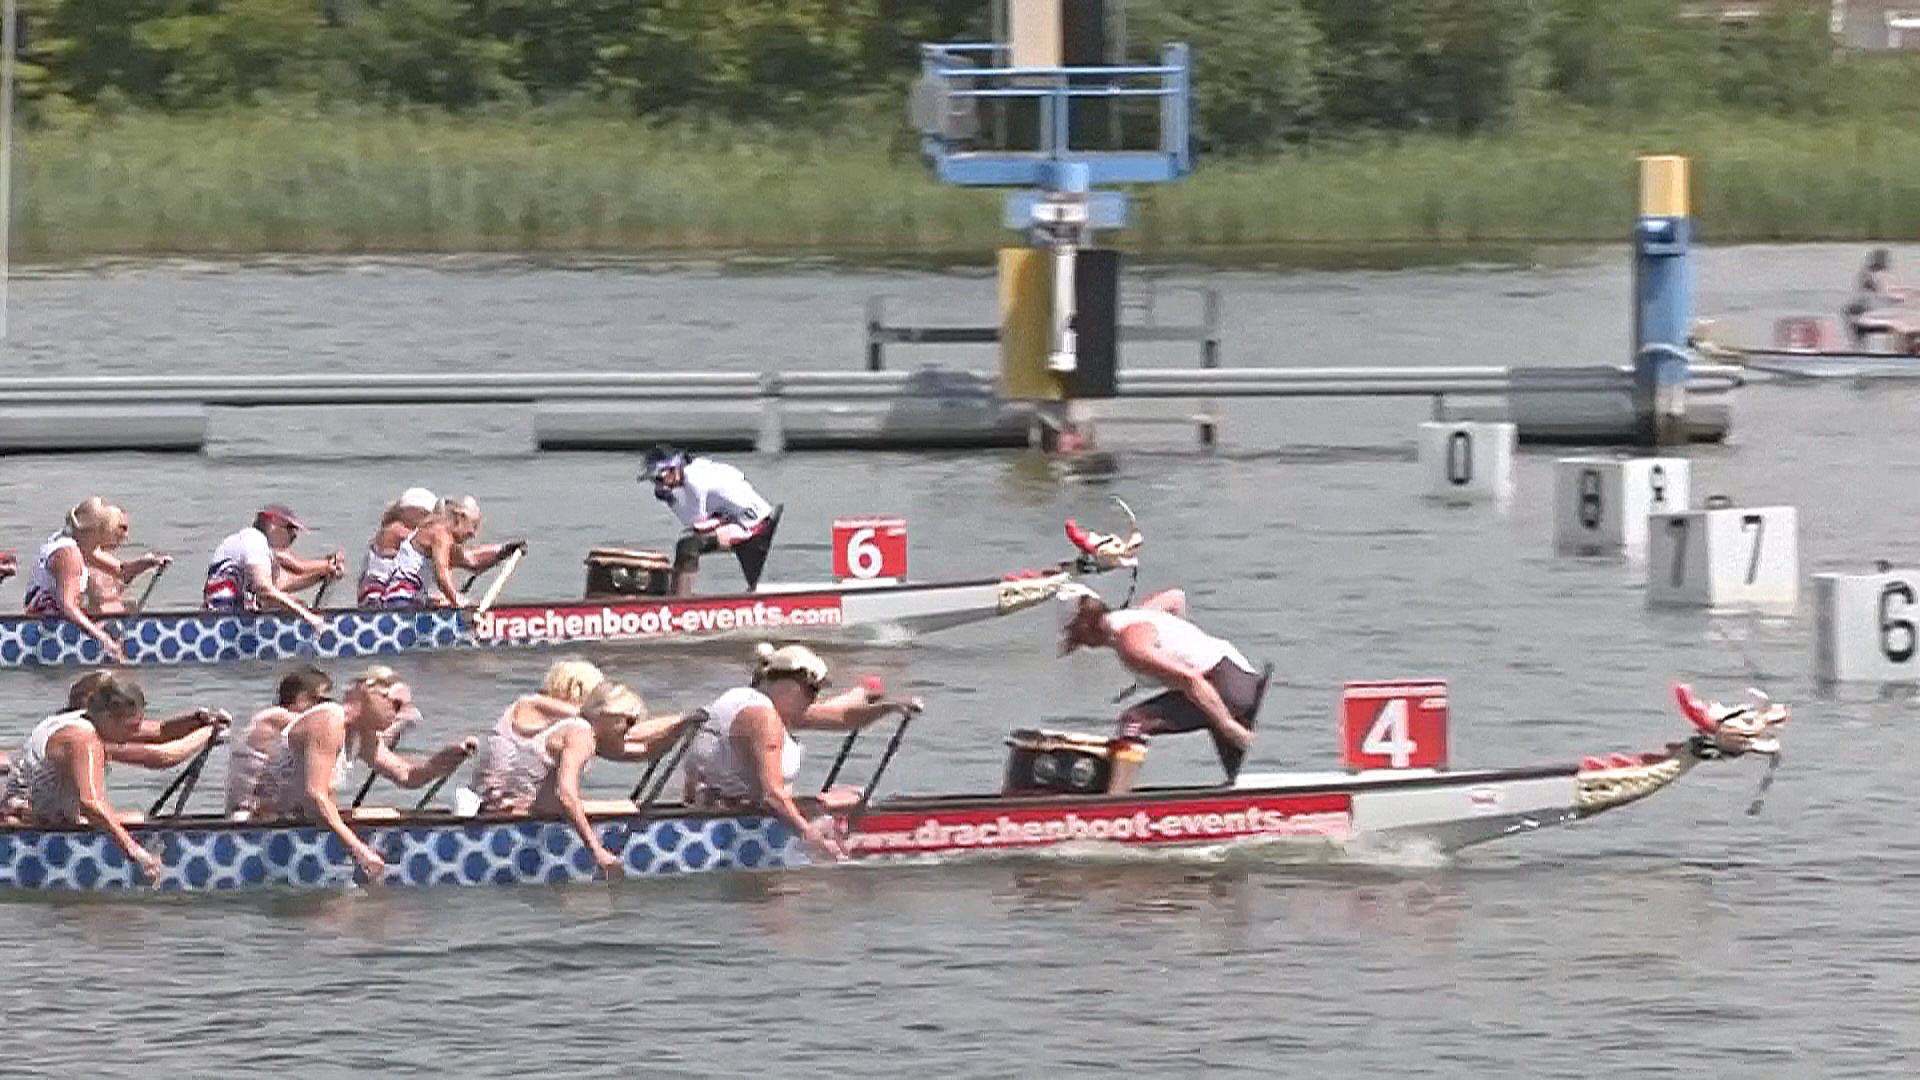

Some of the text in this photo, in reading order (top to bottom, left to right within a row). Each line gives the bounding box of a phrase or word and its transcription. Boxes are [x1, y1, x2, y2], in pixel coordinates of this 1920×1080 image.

[1447, 431, 1473, 486] 0
[847, 528, 883, 578] 6
[1665, 516, 1689, 588] 7
[1741, 514, 1764, 586] 7
[1879, 581, 1917, 663] 6
[1361, 699, 1417, 768] 4
